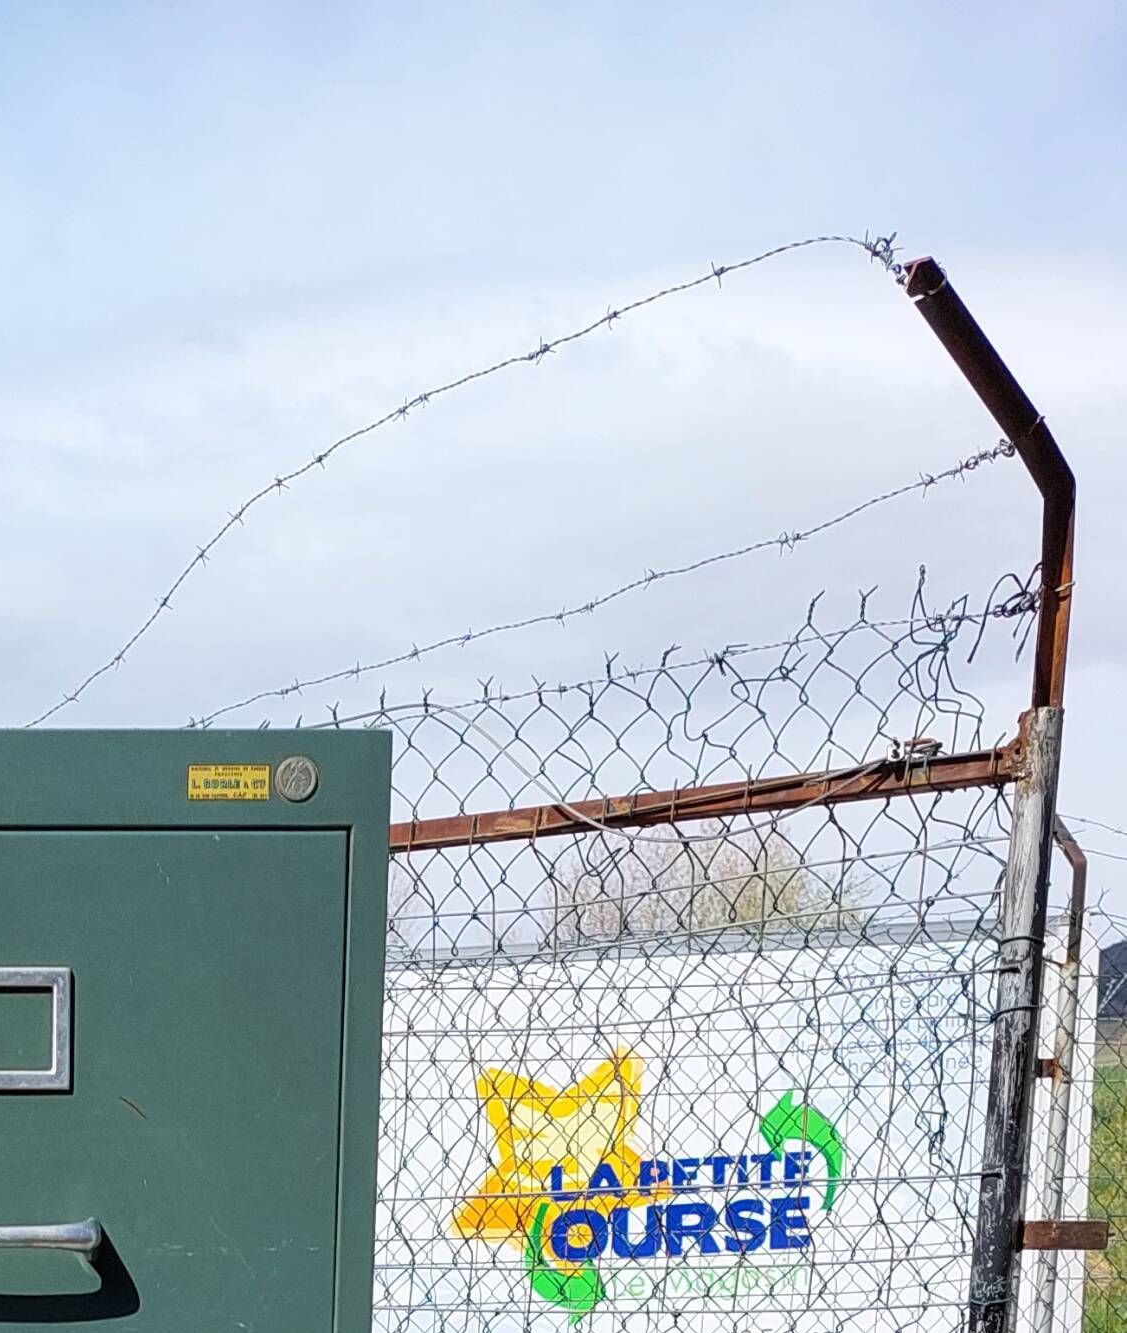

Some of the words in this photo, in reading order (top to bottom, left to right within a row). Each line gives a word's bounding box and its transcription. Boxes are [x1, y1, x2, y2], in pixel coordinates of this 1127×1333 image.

[551, 1162, 623, 1200] LA
[639, 1151, 812, 1196] PETITE
[550, 1196, 811, 1262] OURSE
